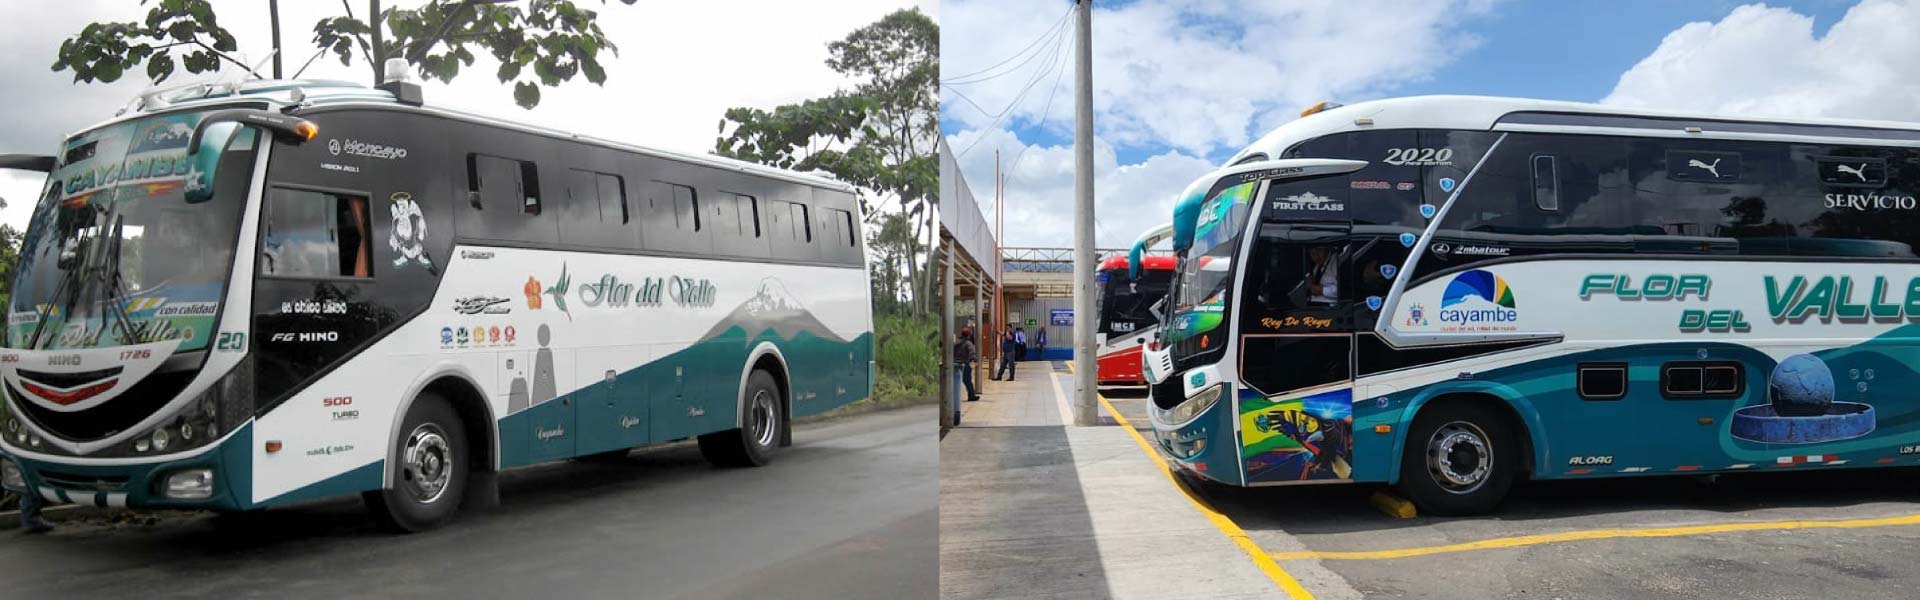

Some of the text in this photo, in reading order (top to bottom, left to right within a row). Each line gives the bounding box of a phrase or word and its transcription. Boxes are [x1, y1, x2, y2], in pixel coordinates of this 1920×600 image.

[1382, 148, 1453, 166] 2020
[1273, 202, 1344, 211] FIRST CLASS
[1824, 193, 1916, 210] SERVICIO
[578, 273, 717, 308] Flor del Valle
[1579, 274, 1711, 300] FLOR
[160, 303, 217, 315] con calidad
[1262, 317, 1283, 329] Rey
[1302, 316, 1333, 328] Reyes
[1440, 307, 1517, 325] cayambe
[1679, 310, 1750, 332] DEL
[217, 332, 246, 350] 20
[271, 330, 338, 342] FG HINO
[47, 354, 82, 365] HINO
[119, 349, 151, 360] 1726
[323, 396, 352, 407] 500
[1569, 455, 1613, 465] ALOAG
